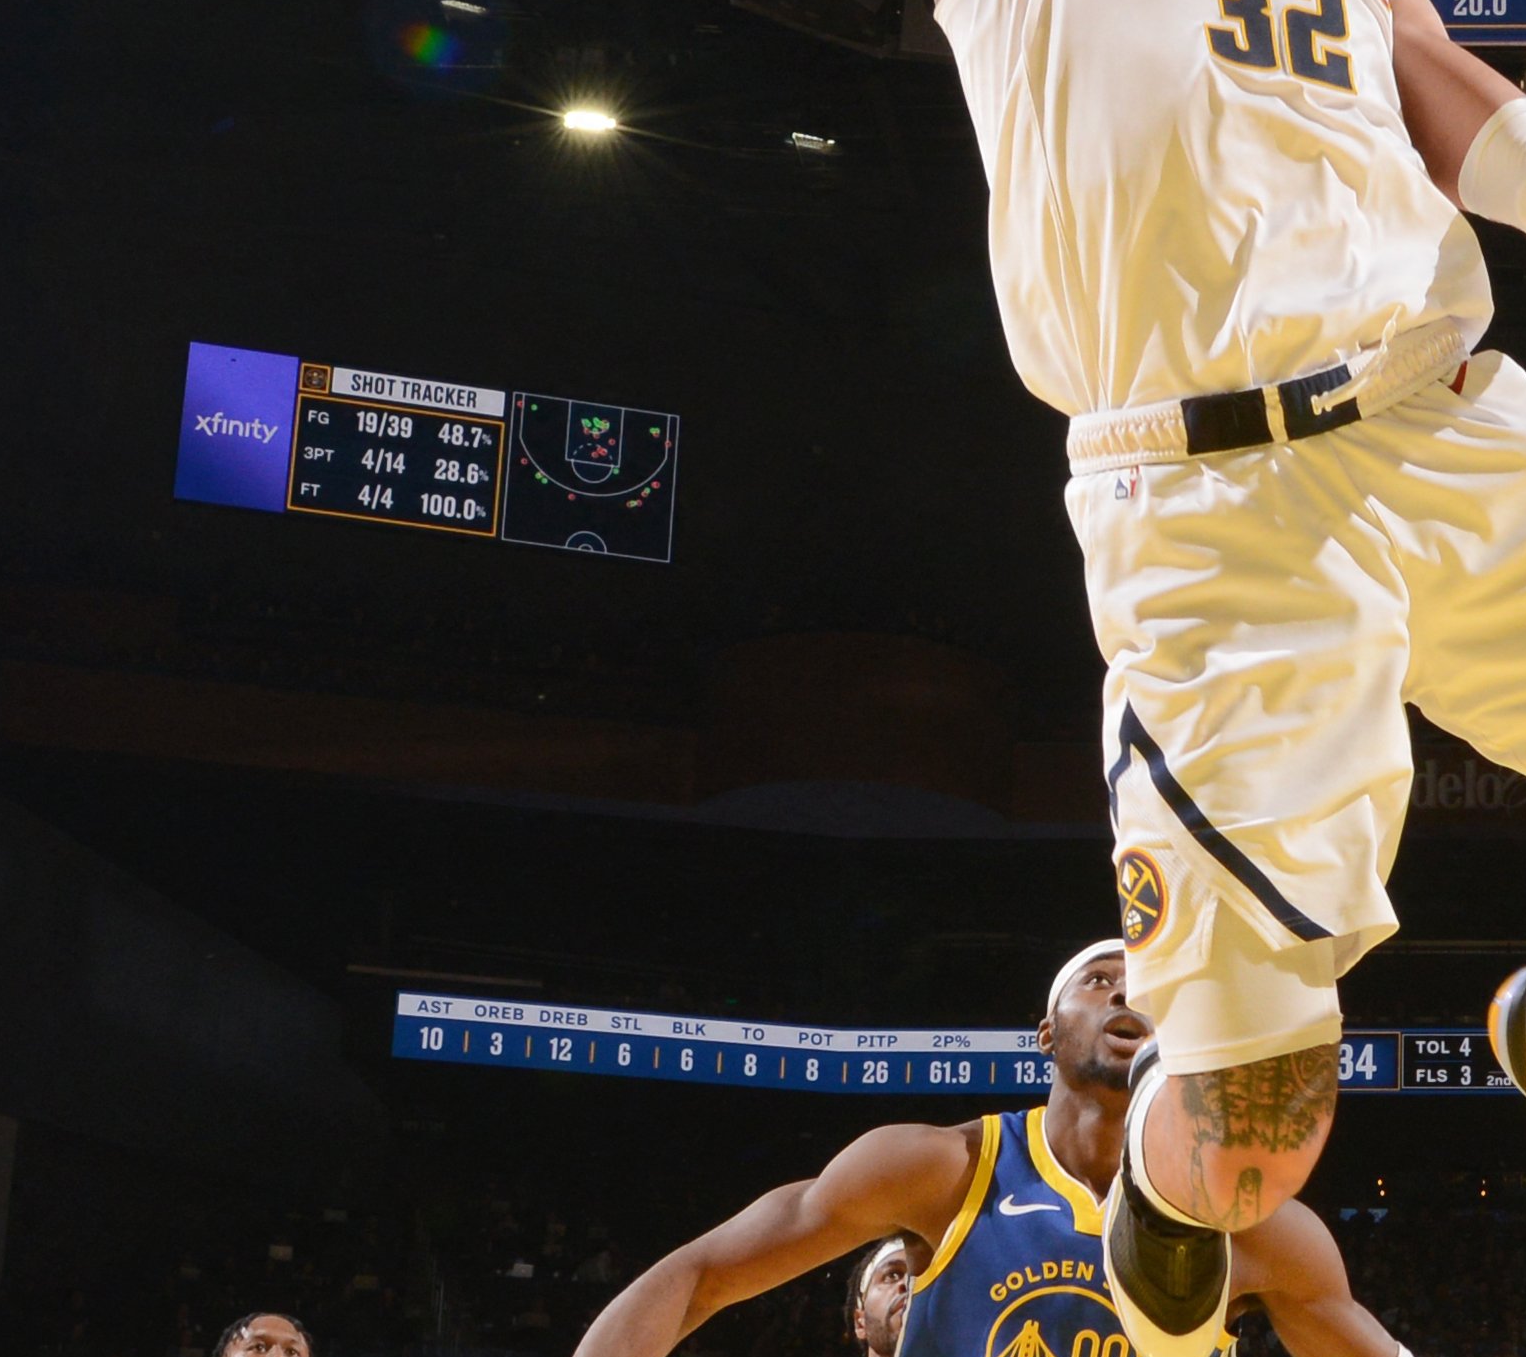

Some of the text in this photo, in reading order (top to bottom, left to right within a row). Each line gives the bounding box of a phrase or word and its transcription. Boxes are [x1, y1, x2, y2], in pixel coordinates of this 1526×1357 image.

[351, 373, 477, 408] SHOT TRACKER
[194, 411, 278, 443] xfinity
[307, 409, 413, 438] FG 19/39
[304, 447, 406, 475] 3PT 4/14
[300, 482, 394, 509] FT 4/4
[418, 1001, 897, 1048] AST OREB DREB STL BLK POT PITP
[419, 1026, 971, 1084] 10 12 26 61.9
[1415, 1040, 1450, 1055] TOL
[1416, 1069, 1448, 1083] FLS
[990, 1260, 1094, 1302] GOLDEN
